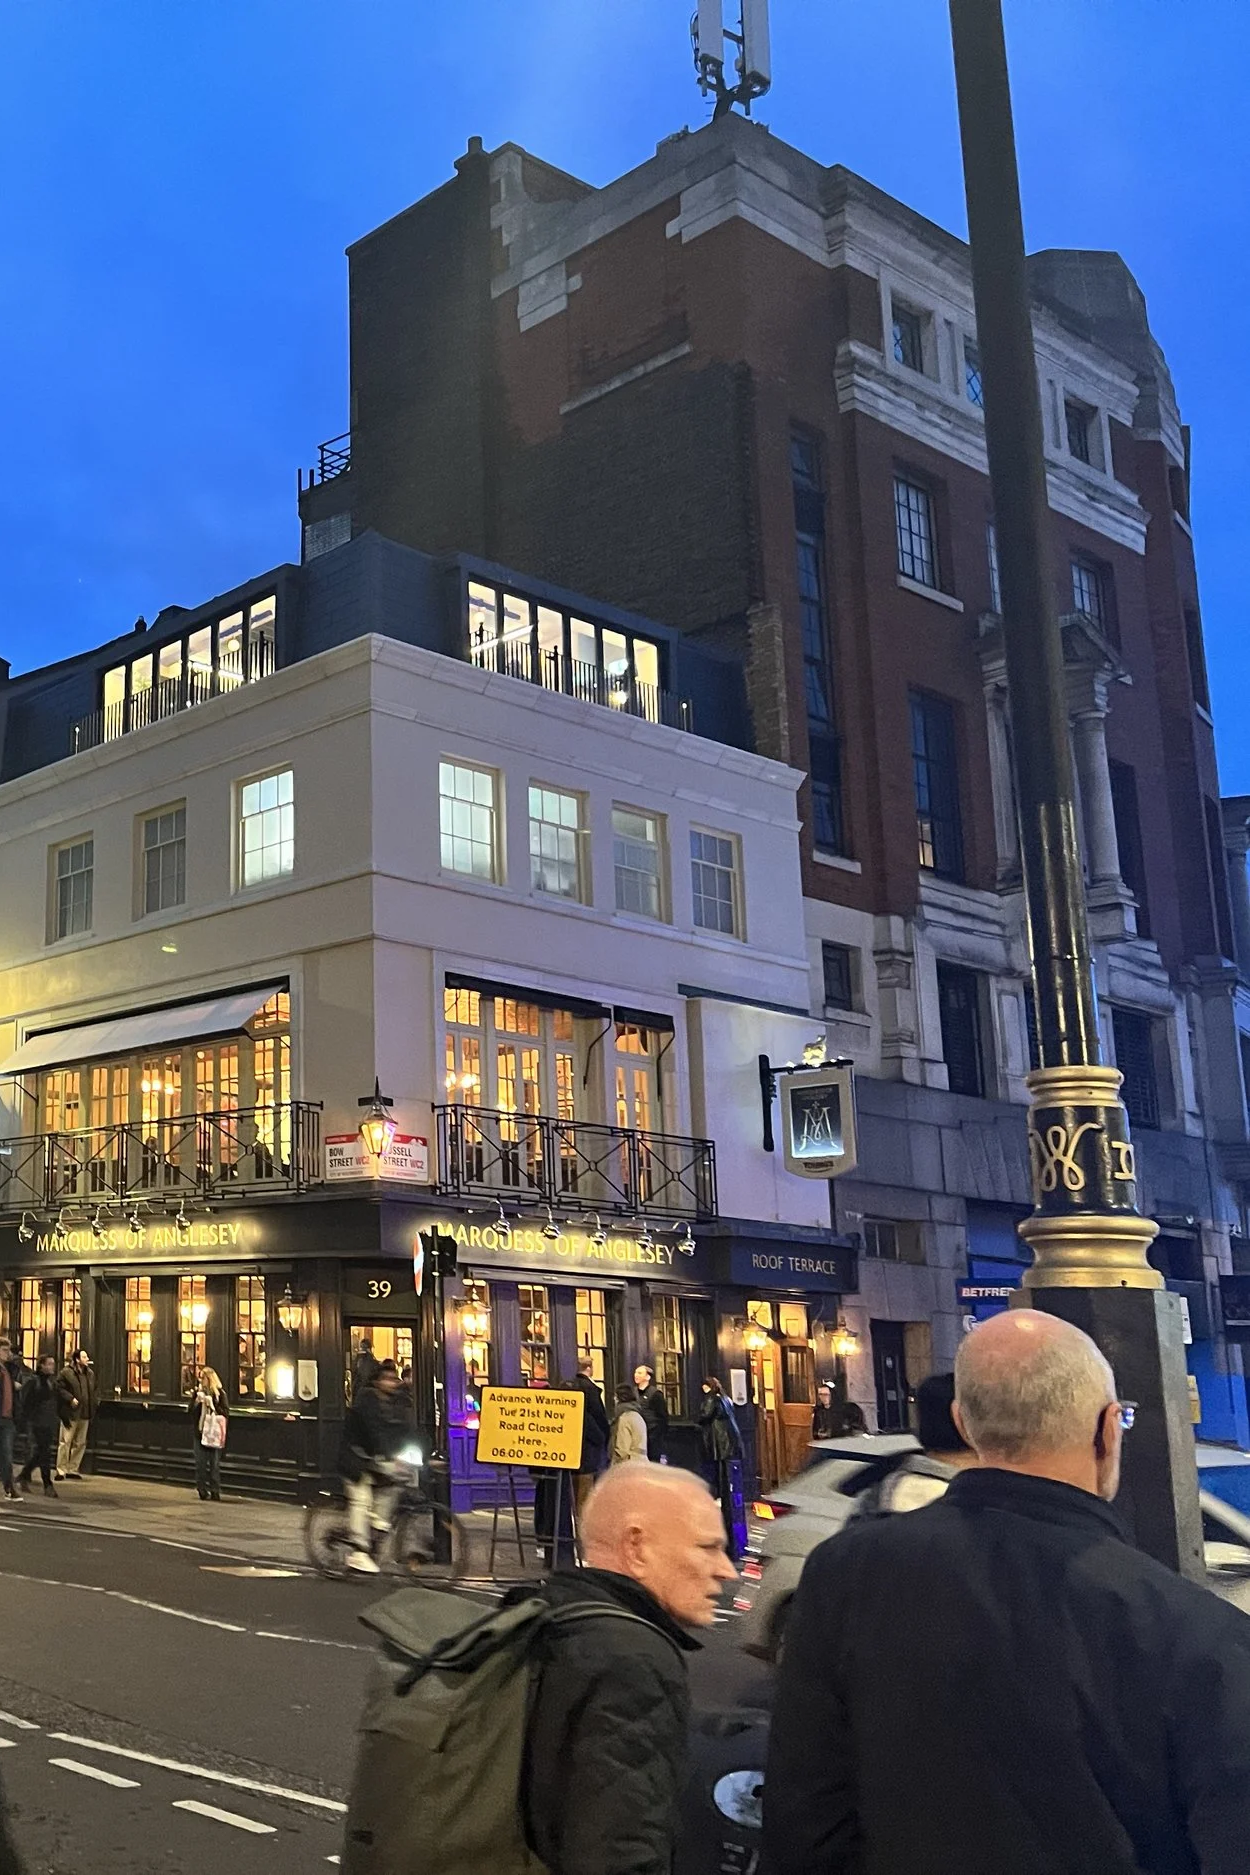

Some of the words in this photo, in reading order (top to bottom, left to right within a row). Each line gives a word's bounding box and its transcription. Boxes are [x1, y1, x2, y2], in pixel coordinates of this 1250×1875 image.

[329, 1147, 344, 1157] BOW
[390, 1146, 412, 1157] SSELL
[330, 1157, 354, 1168] STREET
[355, 1156, 370, 1165] WC2
[383, 1157, 408, 1168] STREET
[410, 1160, 424, 1170] WC2
[36, 1229, 118, 1253] MARQUESS
[124, 1229, 146, 1249] OF
[152, 1223, 241, 1248] ANGLESEY
[437, 1222, 546, 1254] MARQUESS
[554, 1235, 580, 1257] OF
[588, 1238, 675, 1265] ANGLESEY
[752, 1254, 784, 1270] ROOF
[788, 1257, 836, 1275] TERRACE
[368, 1280, 392, 1298] 39
[490, 1393, 532, 1404] Advance
[535, 1395, 577, 1408] Warning
[500, 1407, 517, 1417] Tue
[520, 1409, 540, 1418] 21st
[544, 1410, 565, 1420] Nov
[499, 1421, 525, 1431] Road
[528, 1423, 564, 1434] Closed
[518, 1436, 542, 1446] Here
